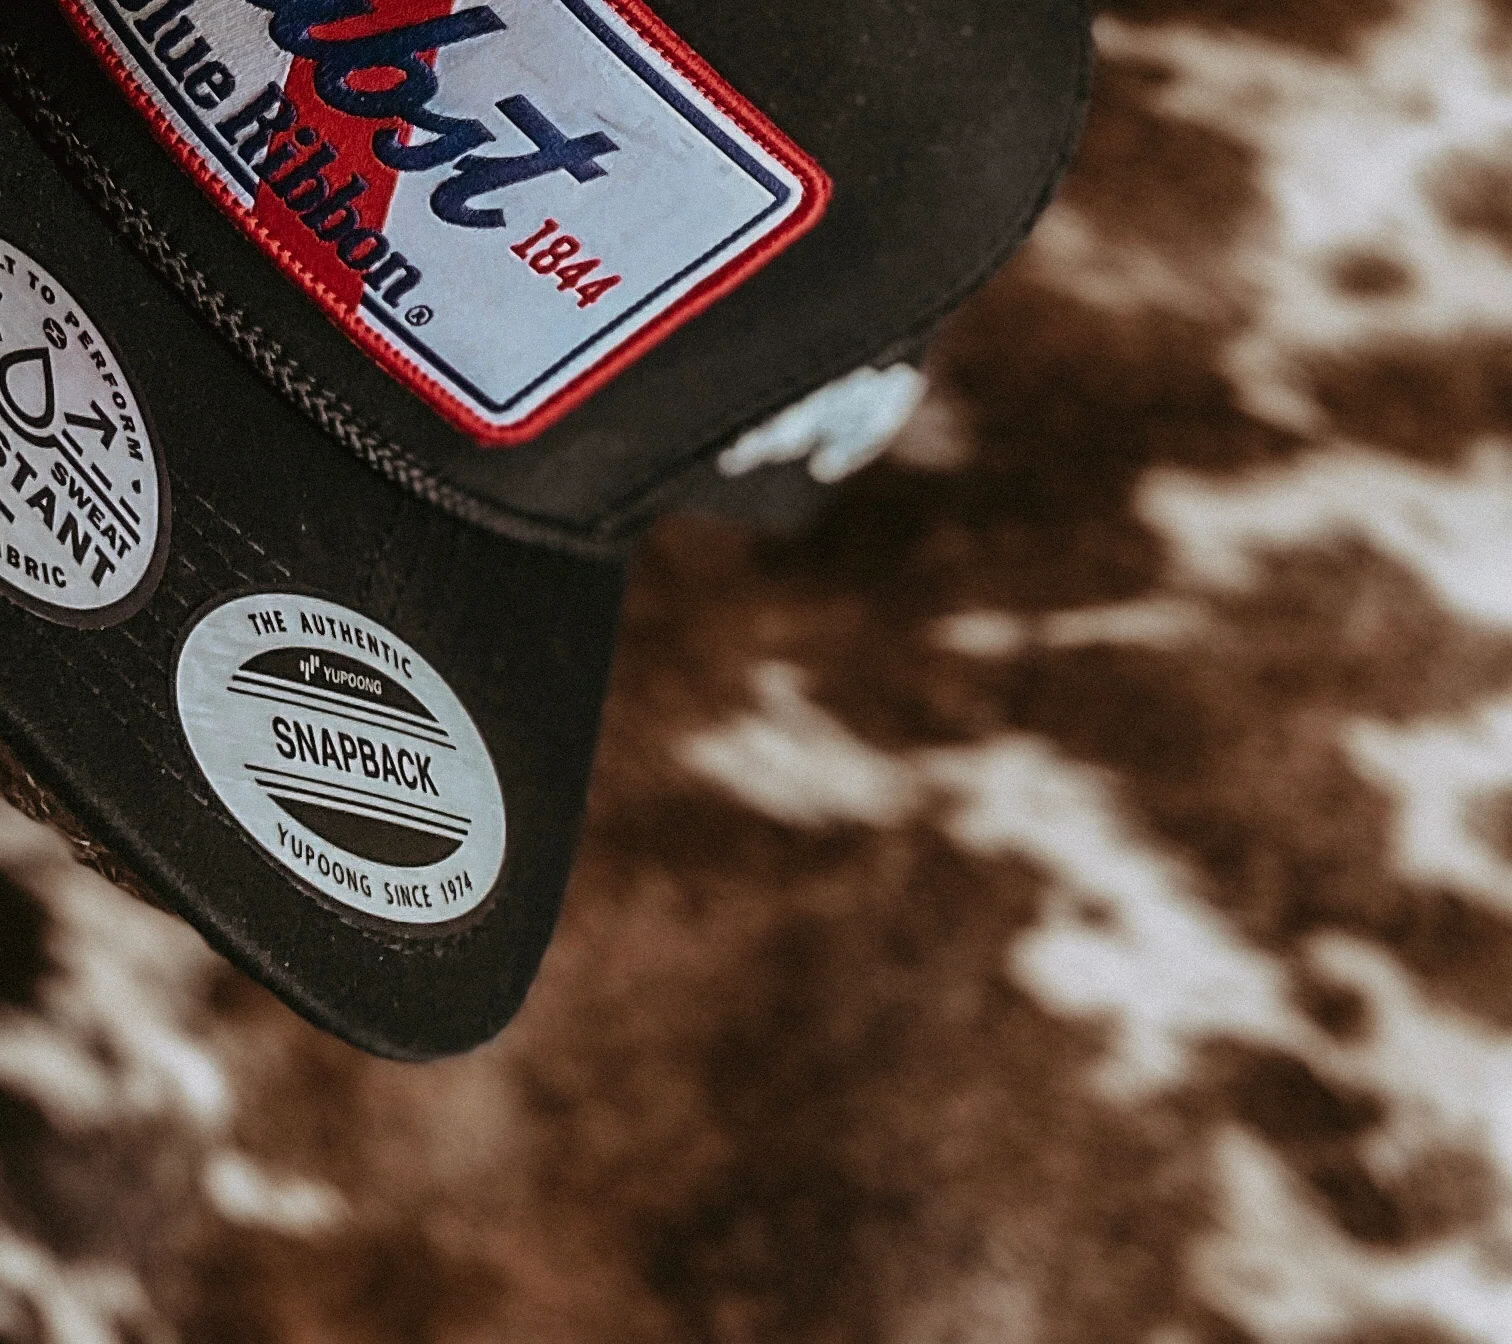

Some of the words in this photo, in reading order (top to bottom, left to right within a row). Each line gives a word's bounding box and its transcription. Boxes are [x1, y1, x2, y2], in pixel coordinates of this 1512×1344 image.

[217, 80, 422, 310] Ribbon
[509, 218, 621, 309] 1844
[27, 270, 56, 305] TO
[64, 310, 144, 463] PERFORM
[51, 461, 131, 559] SWEAT
[248, 610, 287, 637] THE
[300, 612, 413, 679] AUTHENTIC
[323, 666, 382, 696] YUPOONG
[272, 716, 439, 796] SNAPBACK
[277, 823, 372, 897] YUPOONG
[384, 881, 432, 909] SINCE
[440, 870, 473, 905] 1974
